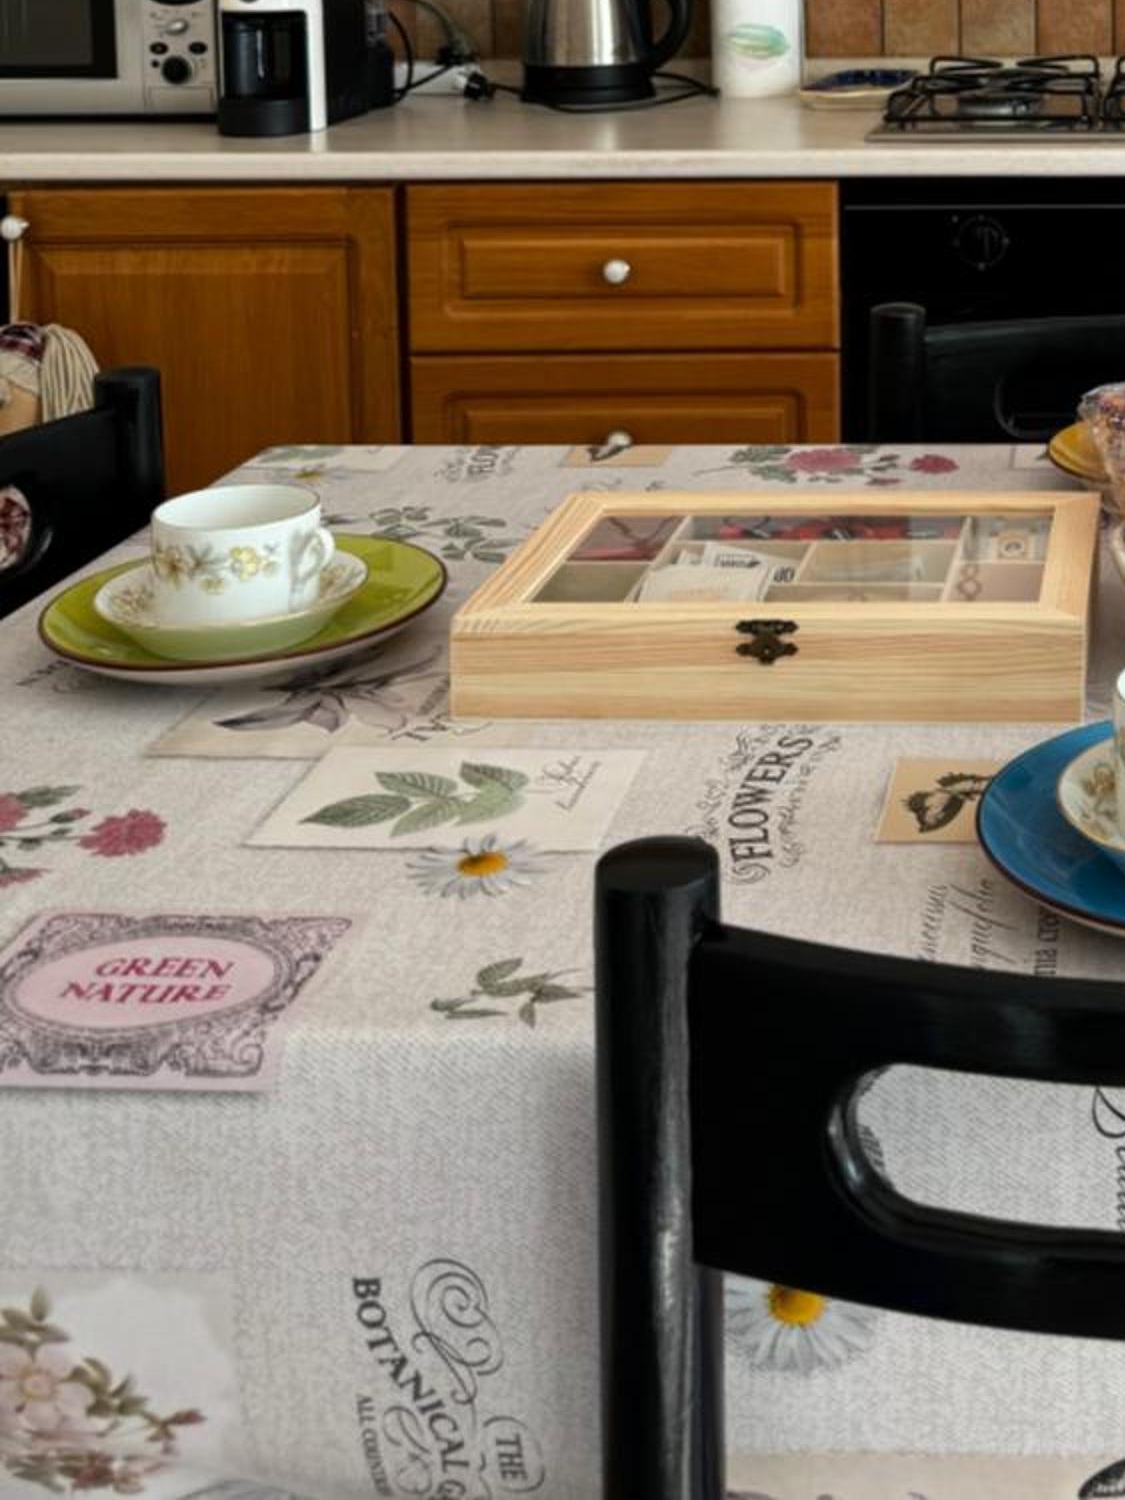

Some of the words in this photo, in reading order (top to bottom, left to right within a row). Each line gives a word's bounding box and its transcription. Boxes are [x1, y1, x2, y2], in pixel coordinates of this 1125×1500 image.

[728, 735, 814, 864] FLOWERS
[95, 957, 236, 979] GREEN
[60, 982, 232, 1004] NATURE
[352, 1276, 471, 1474] BOTANICAL
[495, 1432, 529, 1481] THE
